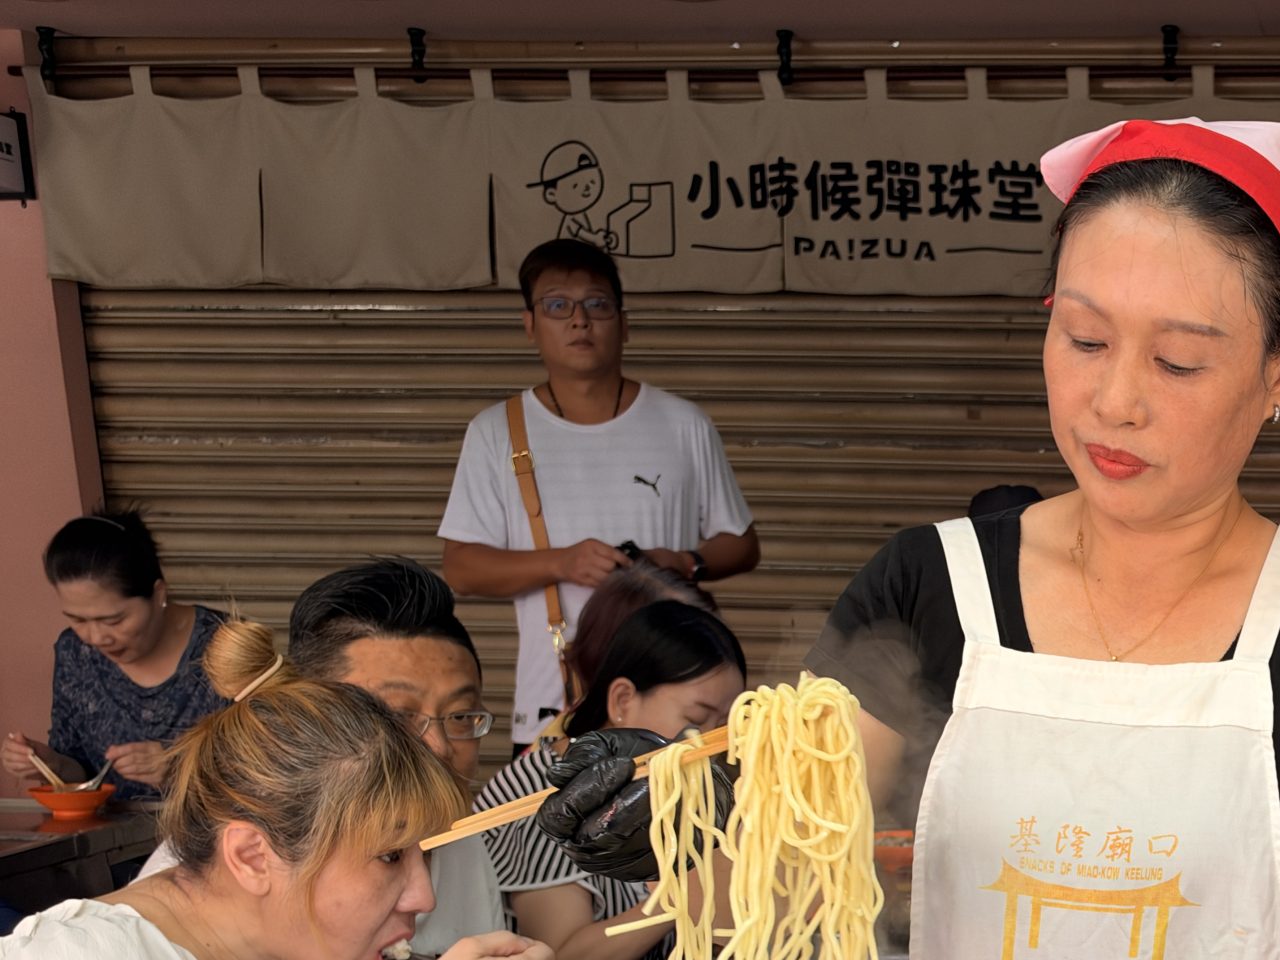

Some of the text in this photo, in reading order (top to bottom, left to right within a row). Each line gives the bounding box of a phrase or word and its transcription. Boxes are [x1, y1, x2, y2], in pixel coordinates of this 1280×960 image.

[687, 156, 1043, 222] 小時候彈珠堂
[1009, 815, 1179, 863] 基隆廟口
[1019, 857, 1163, 881] SNACKS OF MIAO-KOW KEELUNG
